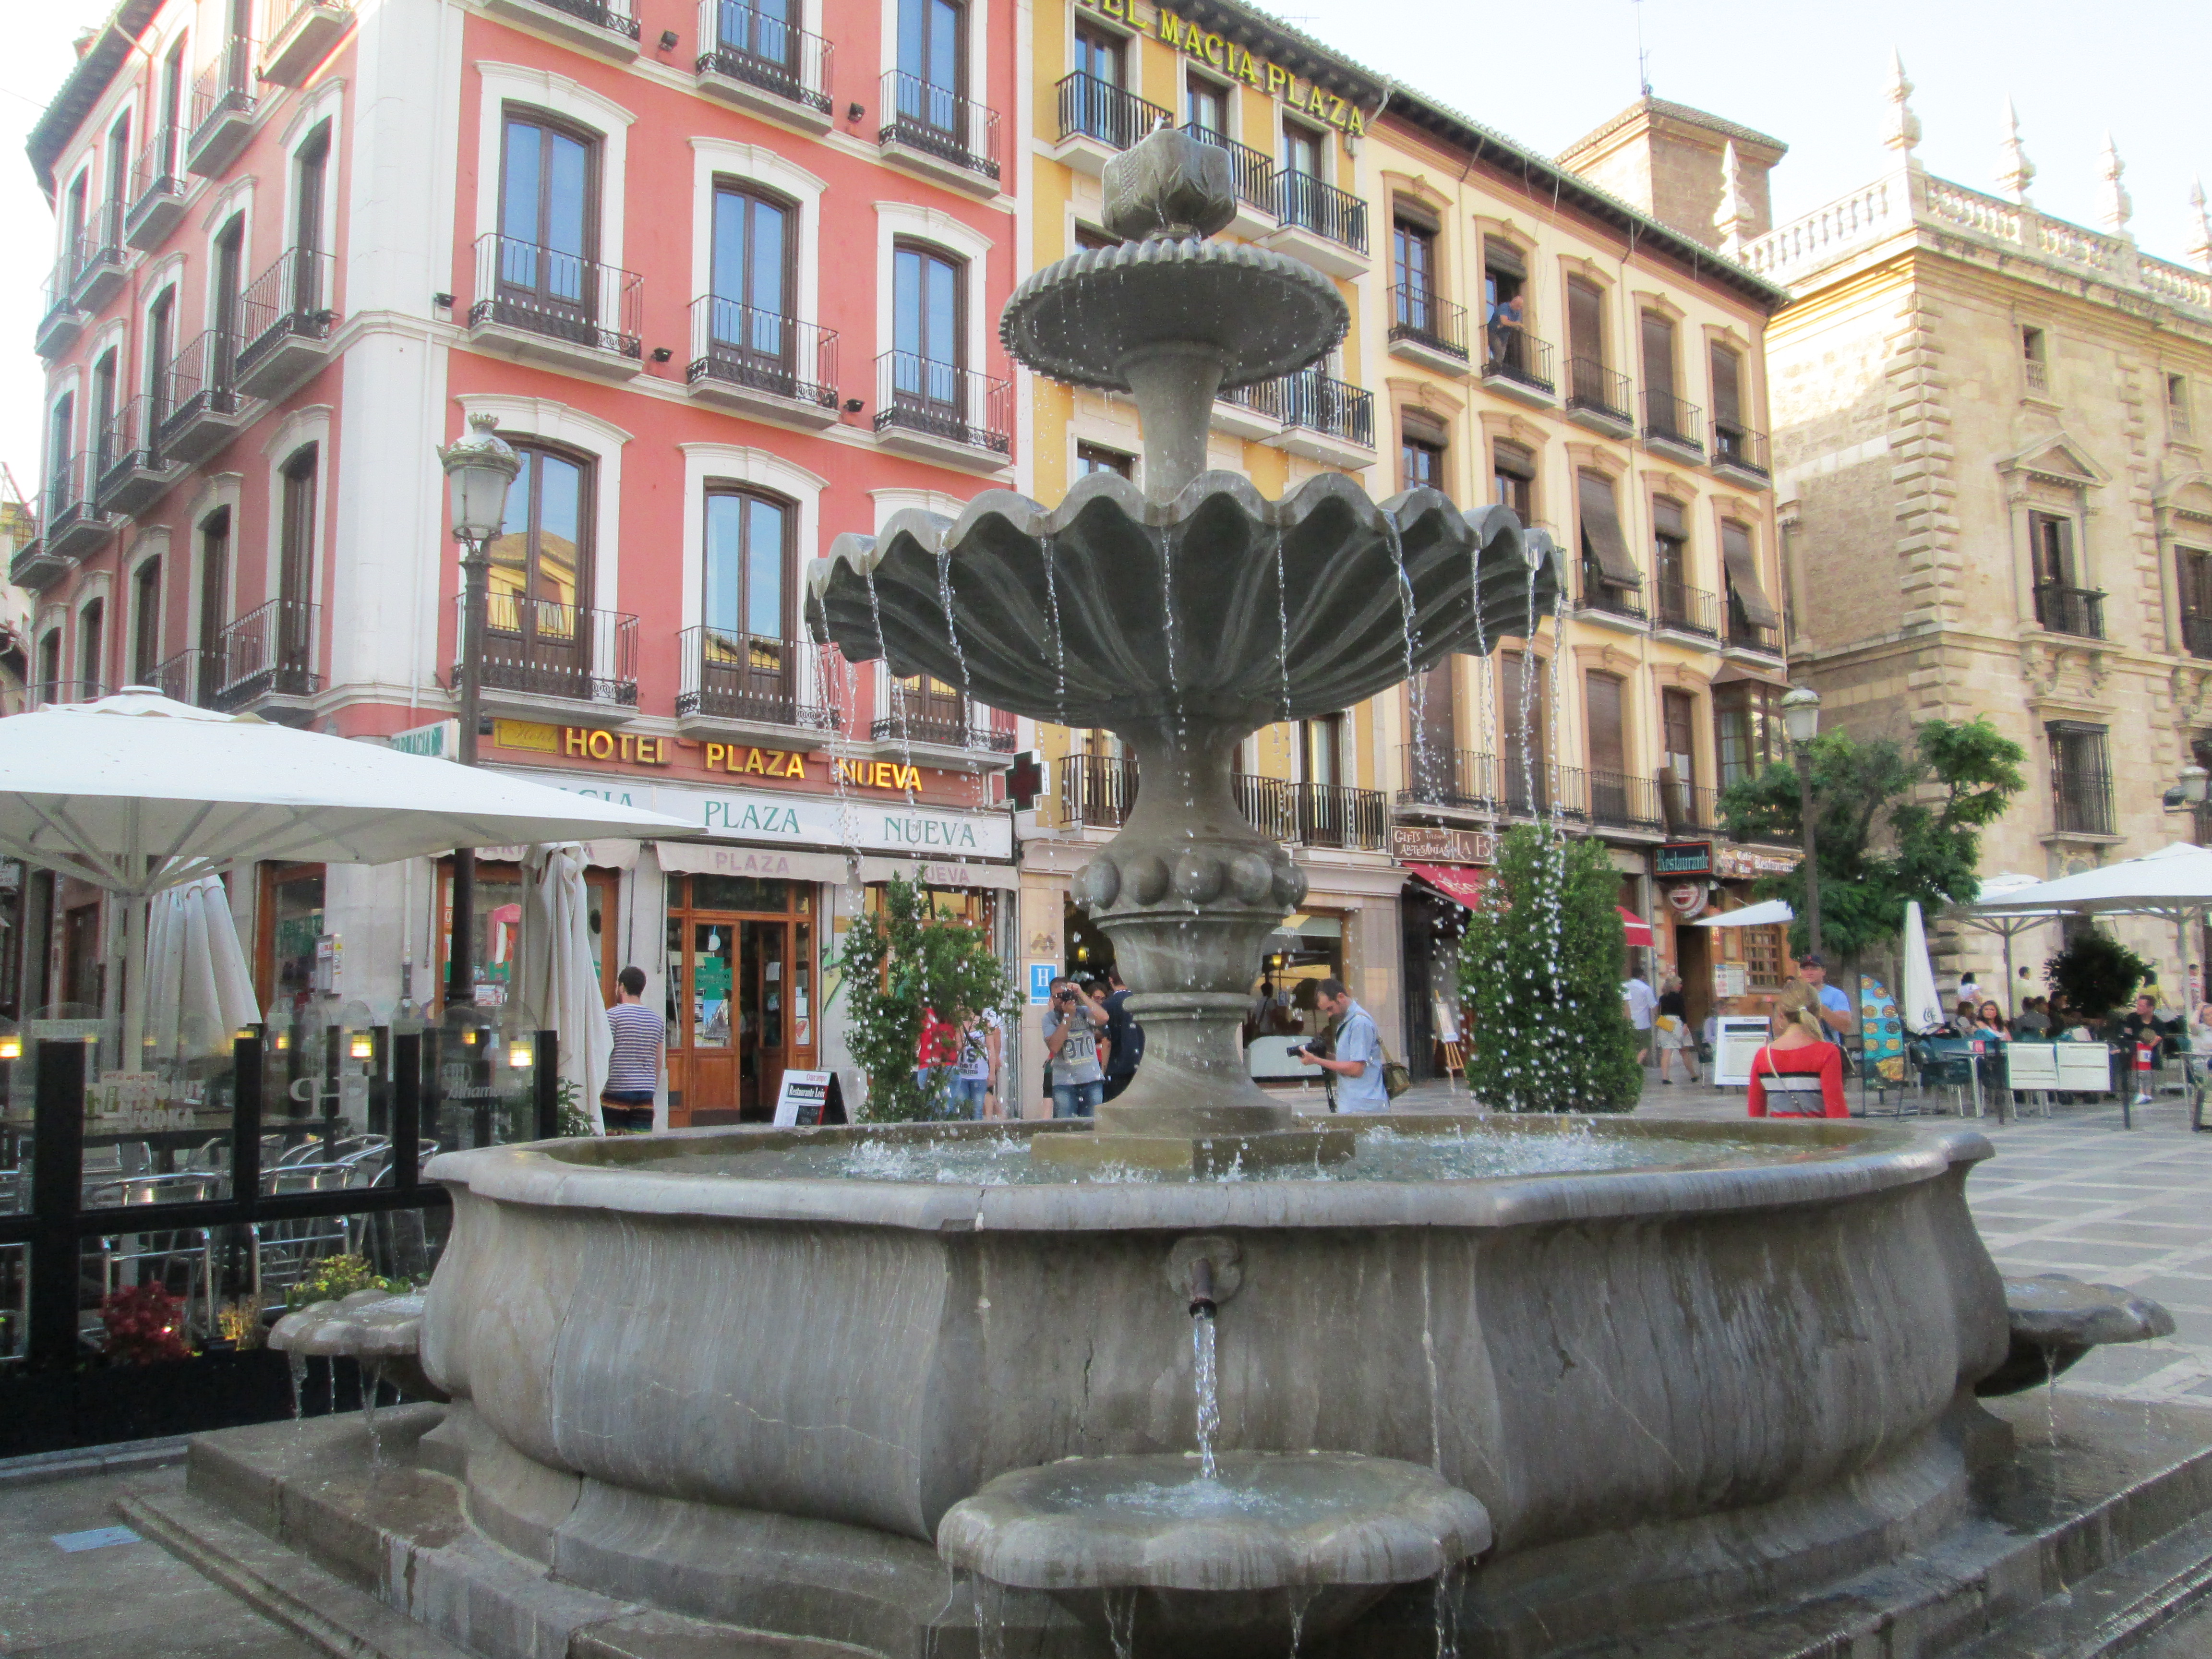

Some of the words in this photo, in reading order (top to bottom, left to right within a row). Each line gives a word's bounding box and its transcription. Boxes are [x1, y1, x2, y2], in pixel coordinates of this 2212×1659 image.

[1160, 8, 1257, 84] MACIA
[1267, 62, 1365, 137] PLAZA
[566, 727, 670, 764] HOTEL
[707, 743, 805, 779] PLAZA
[838, 757, 923, 791] NUEVA
[704, 800, 802, 834] PLAZA
[884, 817, 977, 848] NUEVA
[1456, 833, 1472, 860] LA
[1657, 848, 1709, 871] Restaurante
[715, 851, 790, 874] PLAZA
[911, 863, 970, 883] UEVA
[1037, 968, 1050, 986] H
[789, 1085, 815, 1097] Restaurante
